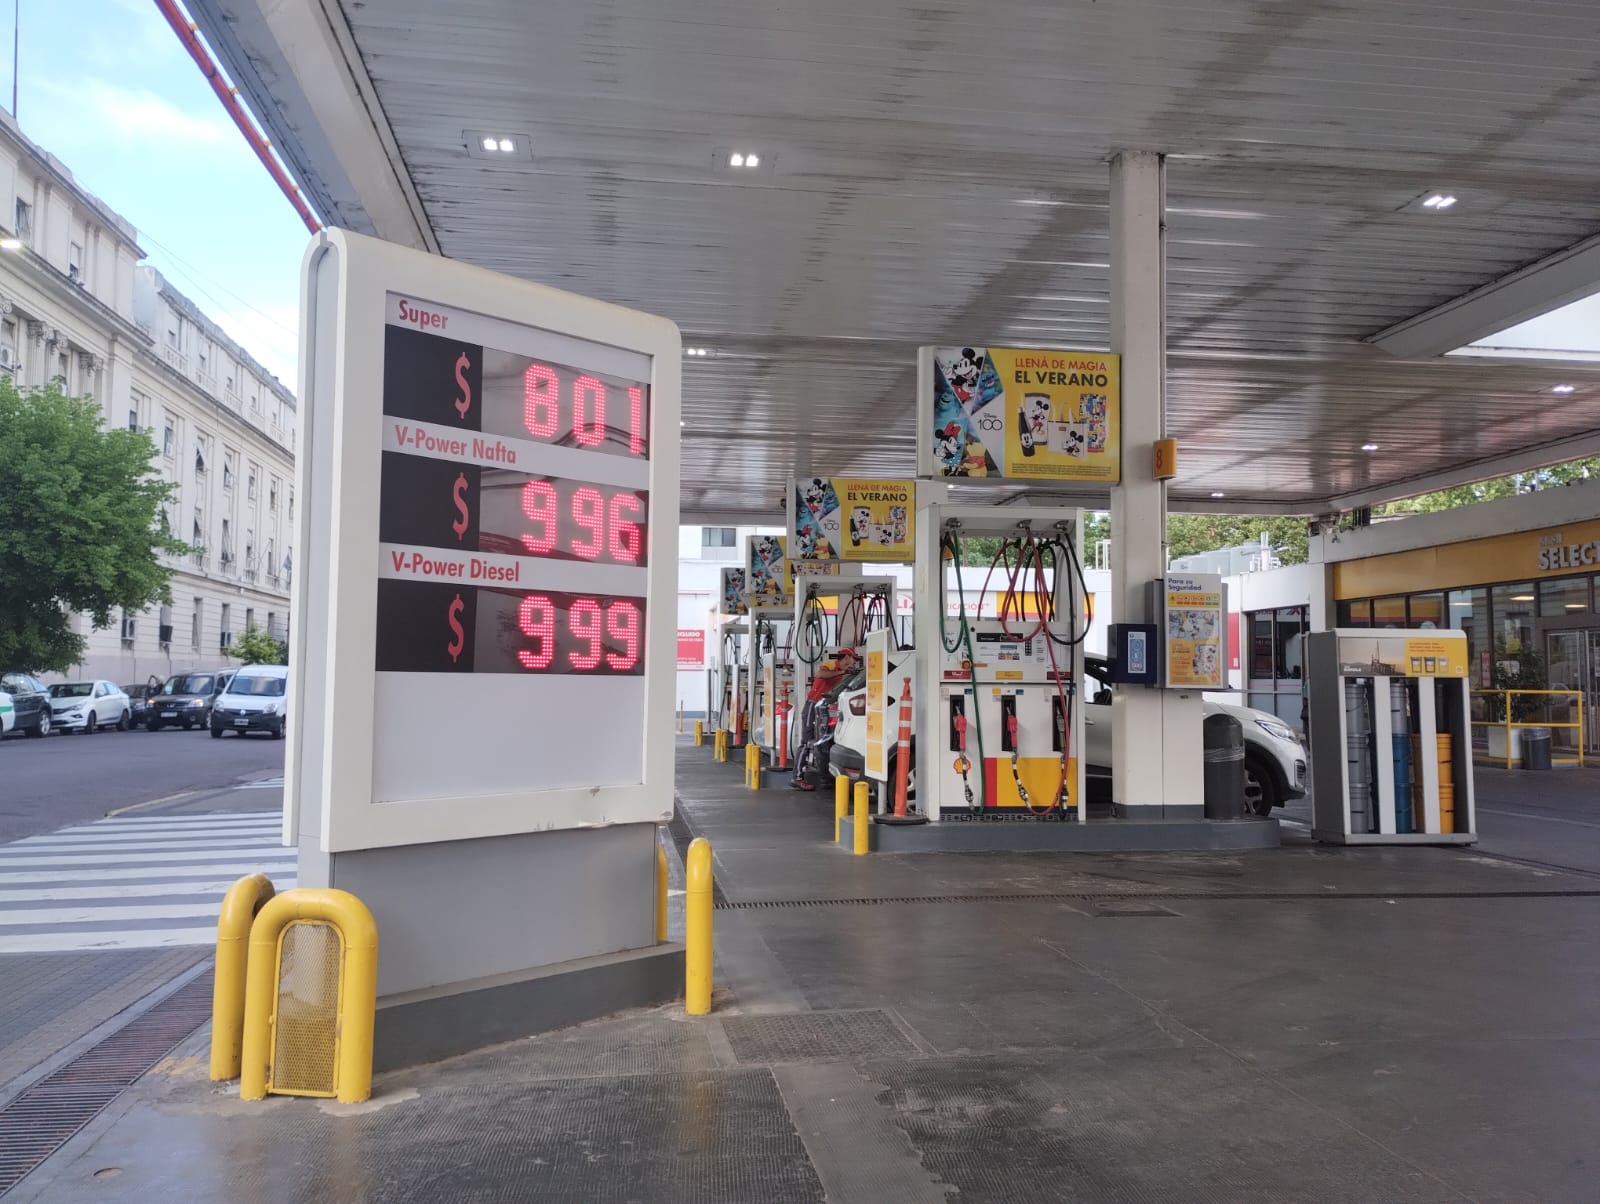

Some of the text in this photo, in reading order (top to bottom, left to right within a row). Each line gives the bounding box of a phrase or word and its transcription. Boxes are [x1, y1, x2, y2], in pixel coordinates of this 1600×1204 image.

[399, 299, 449, 330] Super
[1015, 370, 1108, 387] EL VERANO
[1052, 359, 1065, 370] DE
[1068, 360, 1107, 372] MAGIA
[453, 350, 642, 455] $ 801
[977, 418, 1003, 431] 100
[395, 424, 516, 465] V-Power Nafta
[847, 492, 908, 502] EL VERANO
[881, 485, 907, 493] MAGIA
[452, 471, 641, 563] $ 996
[391, 550, 520, 582] V-Power Diesel
[446, 593, 639, 670] $ 999
